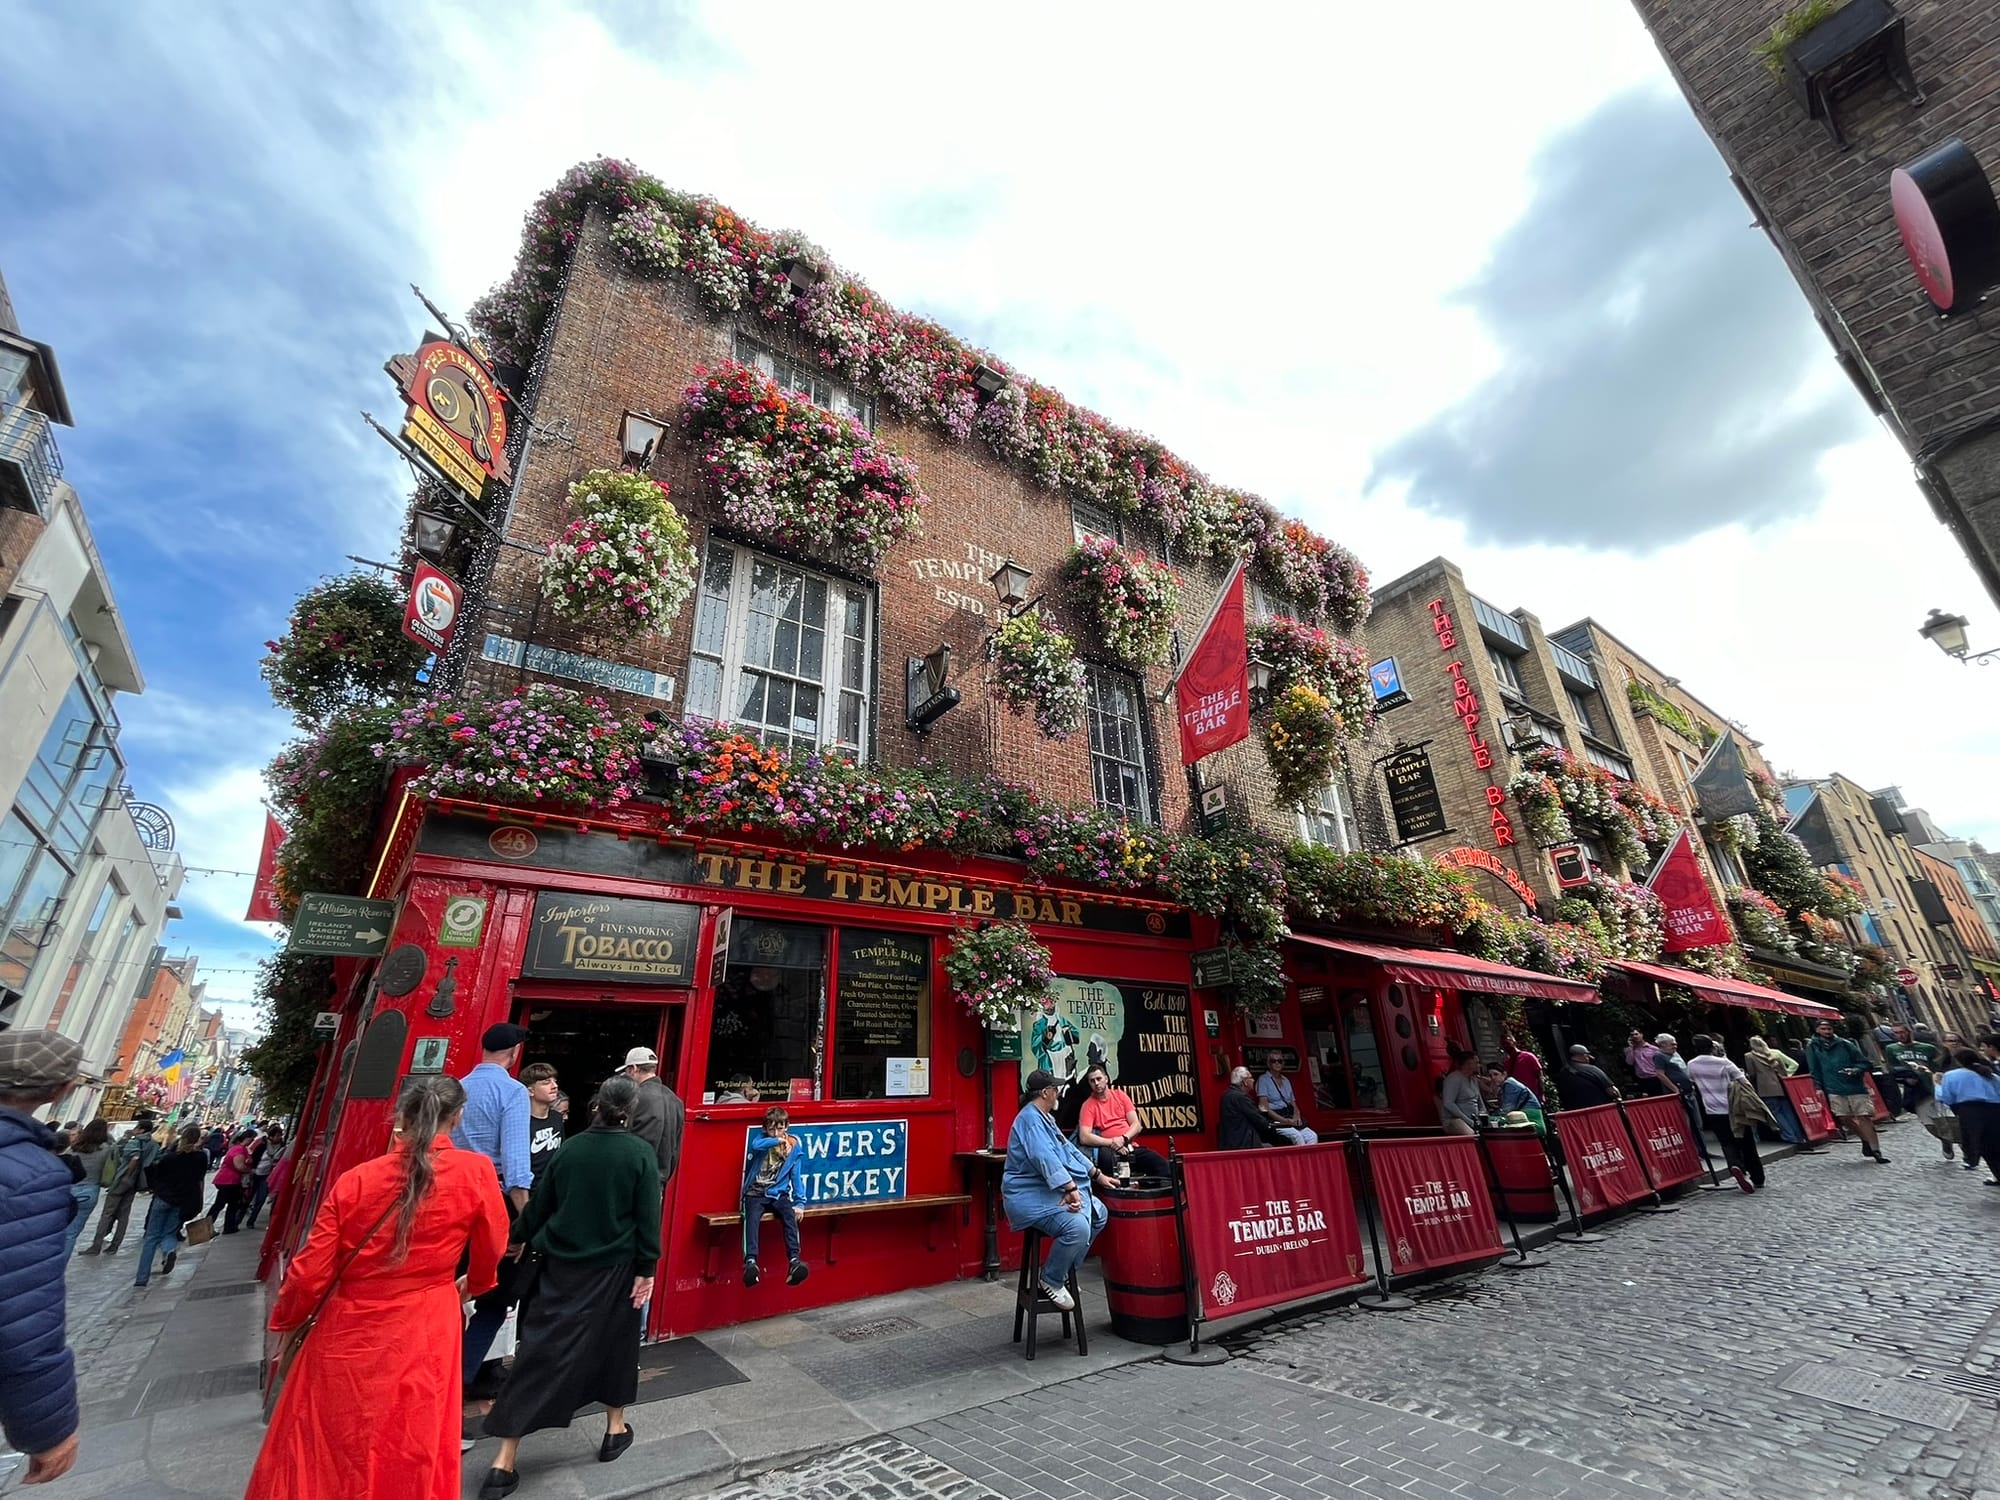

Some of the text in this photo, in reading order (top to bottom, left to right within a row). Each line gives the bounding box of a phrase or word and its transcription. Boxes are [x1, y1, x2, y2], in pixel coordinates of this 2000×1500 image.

[424, 349, 448, 374] THE
[448, 350, 496, 405] TEMPLE
[490, 410, 503, 443] BAR
[428, 422, 474, 470] DUBLIN
[414, 431, 477, 492] LIVE MUSIC
[908, 558, 995, 588] TEMPL
[411, 618, 445, 644] GUINNESS
[1427, 598, 1457, 650] THE
[608, 676, 647, 693] SOUTH
[1199, 689, 1224, 708] THE
[1376, 694, 1406, 712] GUINNESS
[1184, 690, 1242, 727] TEMPLE
[1446, 660, 1494, 771] TEMPLE
[1195, 714, 1227, 736] BAR
[1512, 735, 1542, 750] GUINNESS
[1386, 758, 1428, 778] TEMPLE
[1399, 756, 1412, 765] THE
[1398, 772, 1422, 785] BAR
[1409, 788, 1434, 802] GARDEN
[1410, 819, 1432, 831] DAILY
[1414, 810, 1438, 823] MUSIC
[1485, 785, 1516, 848] BAR
[498, 830, 528, 851] 48
[698, 852, 807, 895] THE
[825, 868, 996, 916] TEMPLE
[1012, 896, 1084, 926] BAR
[1506, 868, 1537, 913] BAR
[540, 902, 610, 925] Importers
[584, 916, 596, 924] OF
[1668, 911, 1716, 928] EMPLE
[1671, 907, 1694, 918] THE
[308, 920, 352, 929] IRELAND'S
[310, 927, 348, 935] LARGEST
[600, 922, 674, 937] FINE SMOKING
[1674, 922, 1704, 936] BAR
[298, 938, 352, 948] COLLECTION
[308, 933, 347, 941] WHISKEY
[556, 925, 673, 964] TOBACCO
[882, 938, 896, 946] The
[852, 946, 922, 964] TEMPLE BAR
[576, 958, 680, 974] Always in Stock
[858, 972, 889, 980] Traditional
[1465, 975, 1530, 993] THE TEMPLE BAR
[1078, 986, 1104, 1002] THE
[1168, 994, 1186, 1012] 1840
[856, 1010, 878, 1018] Toasted
[1066, 1000, 1116, 1016] TEMPLE
[853, 1020, 864, 1028] Hot
[1081, 1015, 1106, 1030] BAR
[1164, 1015, 1188, 1034] THE
[1138, 1034, 1190, 1054] EMPEROR
[1178, 1054, 1190, 1073] OF
[1111, 1074, 1196, 1106] TED LIQUORS
[1138, 1105, 1198, 1130] NNESS
[536, 1127, 554, 1142] JUST
[794, 1128, 896, 1160] WER'S
[1608, 1147, 1625, 1162] BAR
[1425, 1181, 1444, 1194] THE
[1266, 1200, 1292, 1217] THE
[1405, 1190, 1472, 1216] TEMPLE BAR
[1228, 1210, 1328, 1244] TEMPLE BAR
[1256, 1238, 1310, 1256] DUBLIN IRELAND
